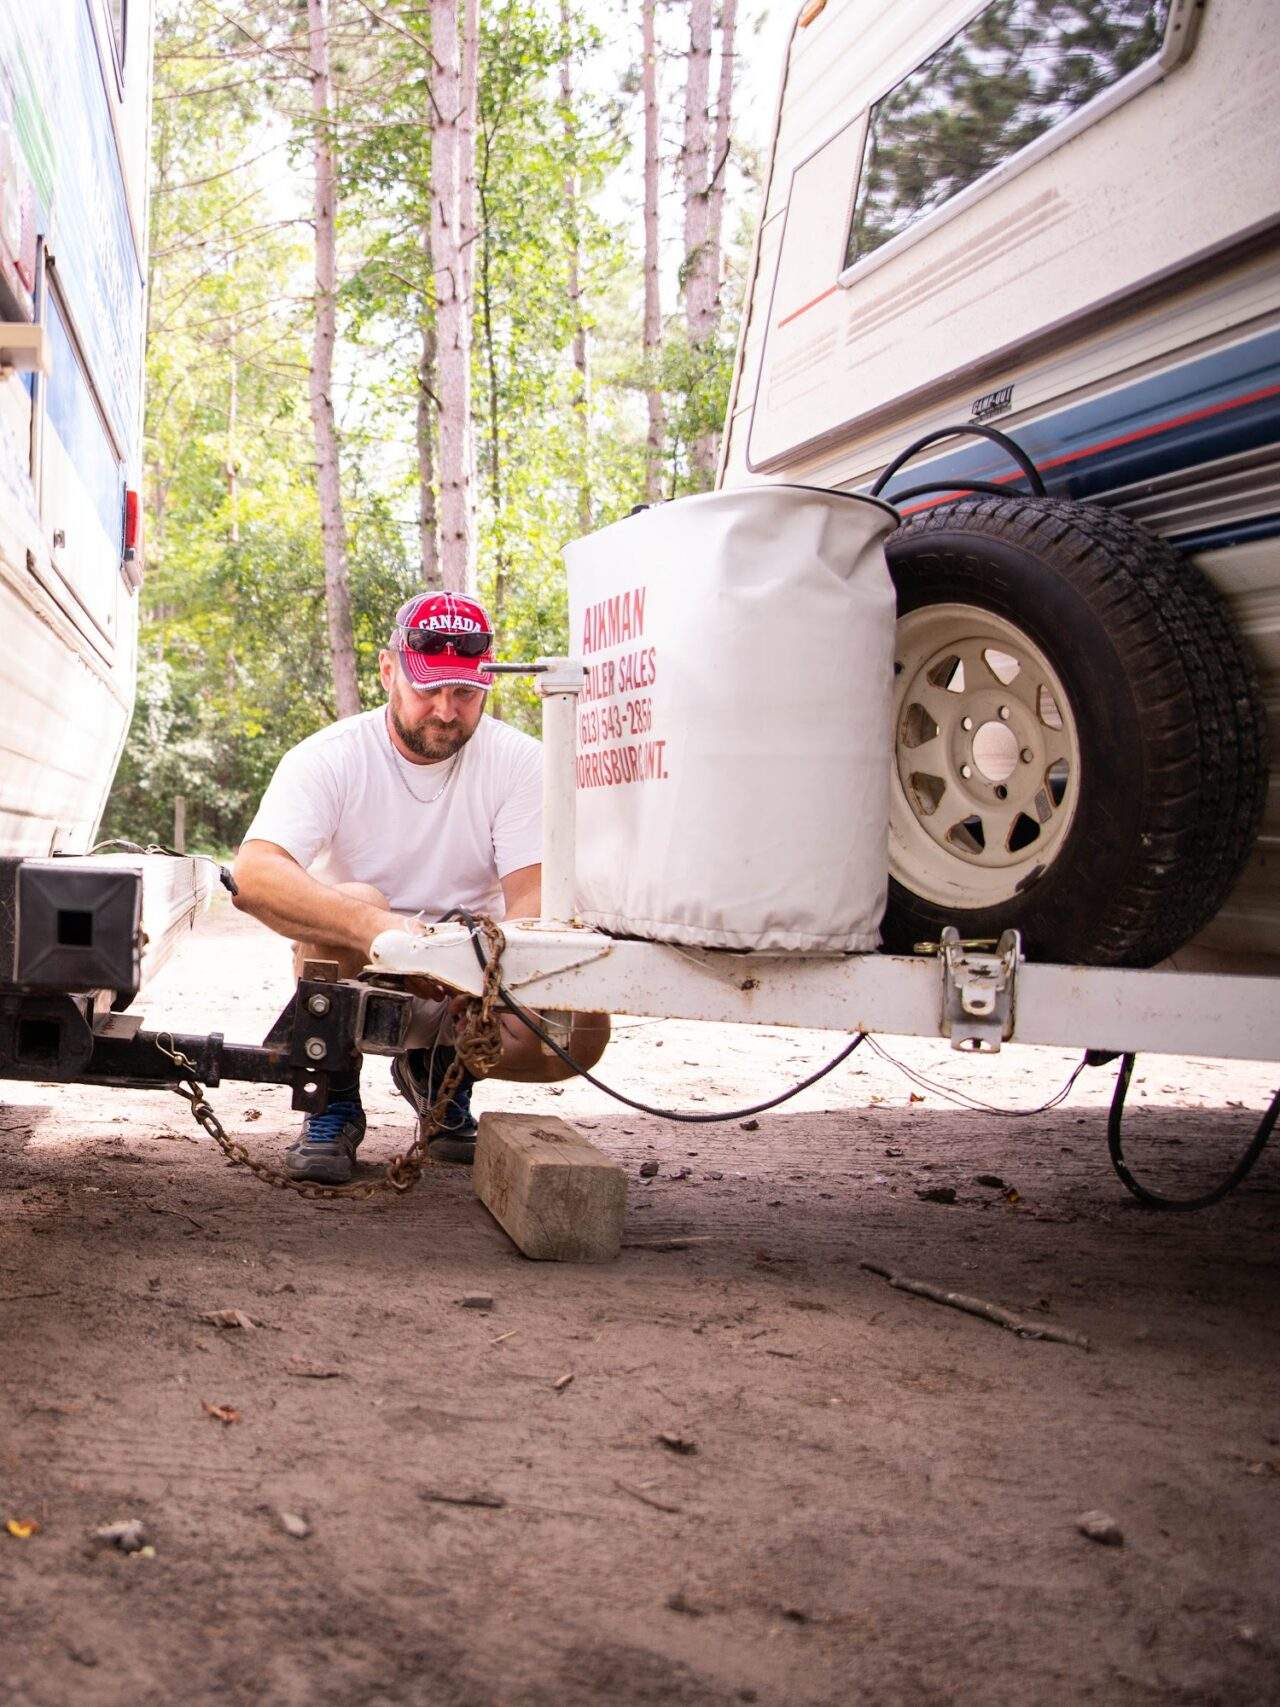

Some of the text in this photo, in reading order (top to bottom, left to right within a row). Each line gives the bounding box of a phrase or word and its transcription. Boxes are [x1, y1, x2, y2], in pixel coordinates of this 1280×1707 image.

[419, 614, 482, 632] CANADA
[583, 587, 646, 655] AIKMAN
[578, 646, 657, 704] AILER SALES
[580, 707, 600, 750] (613)
